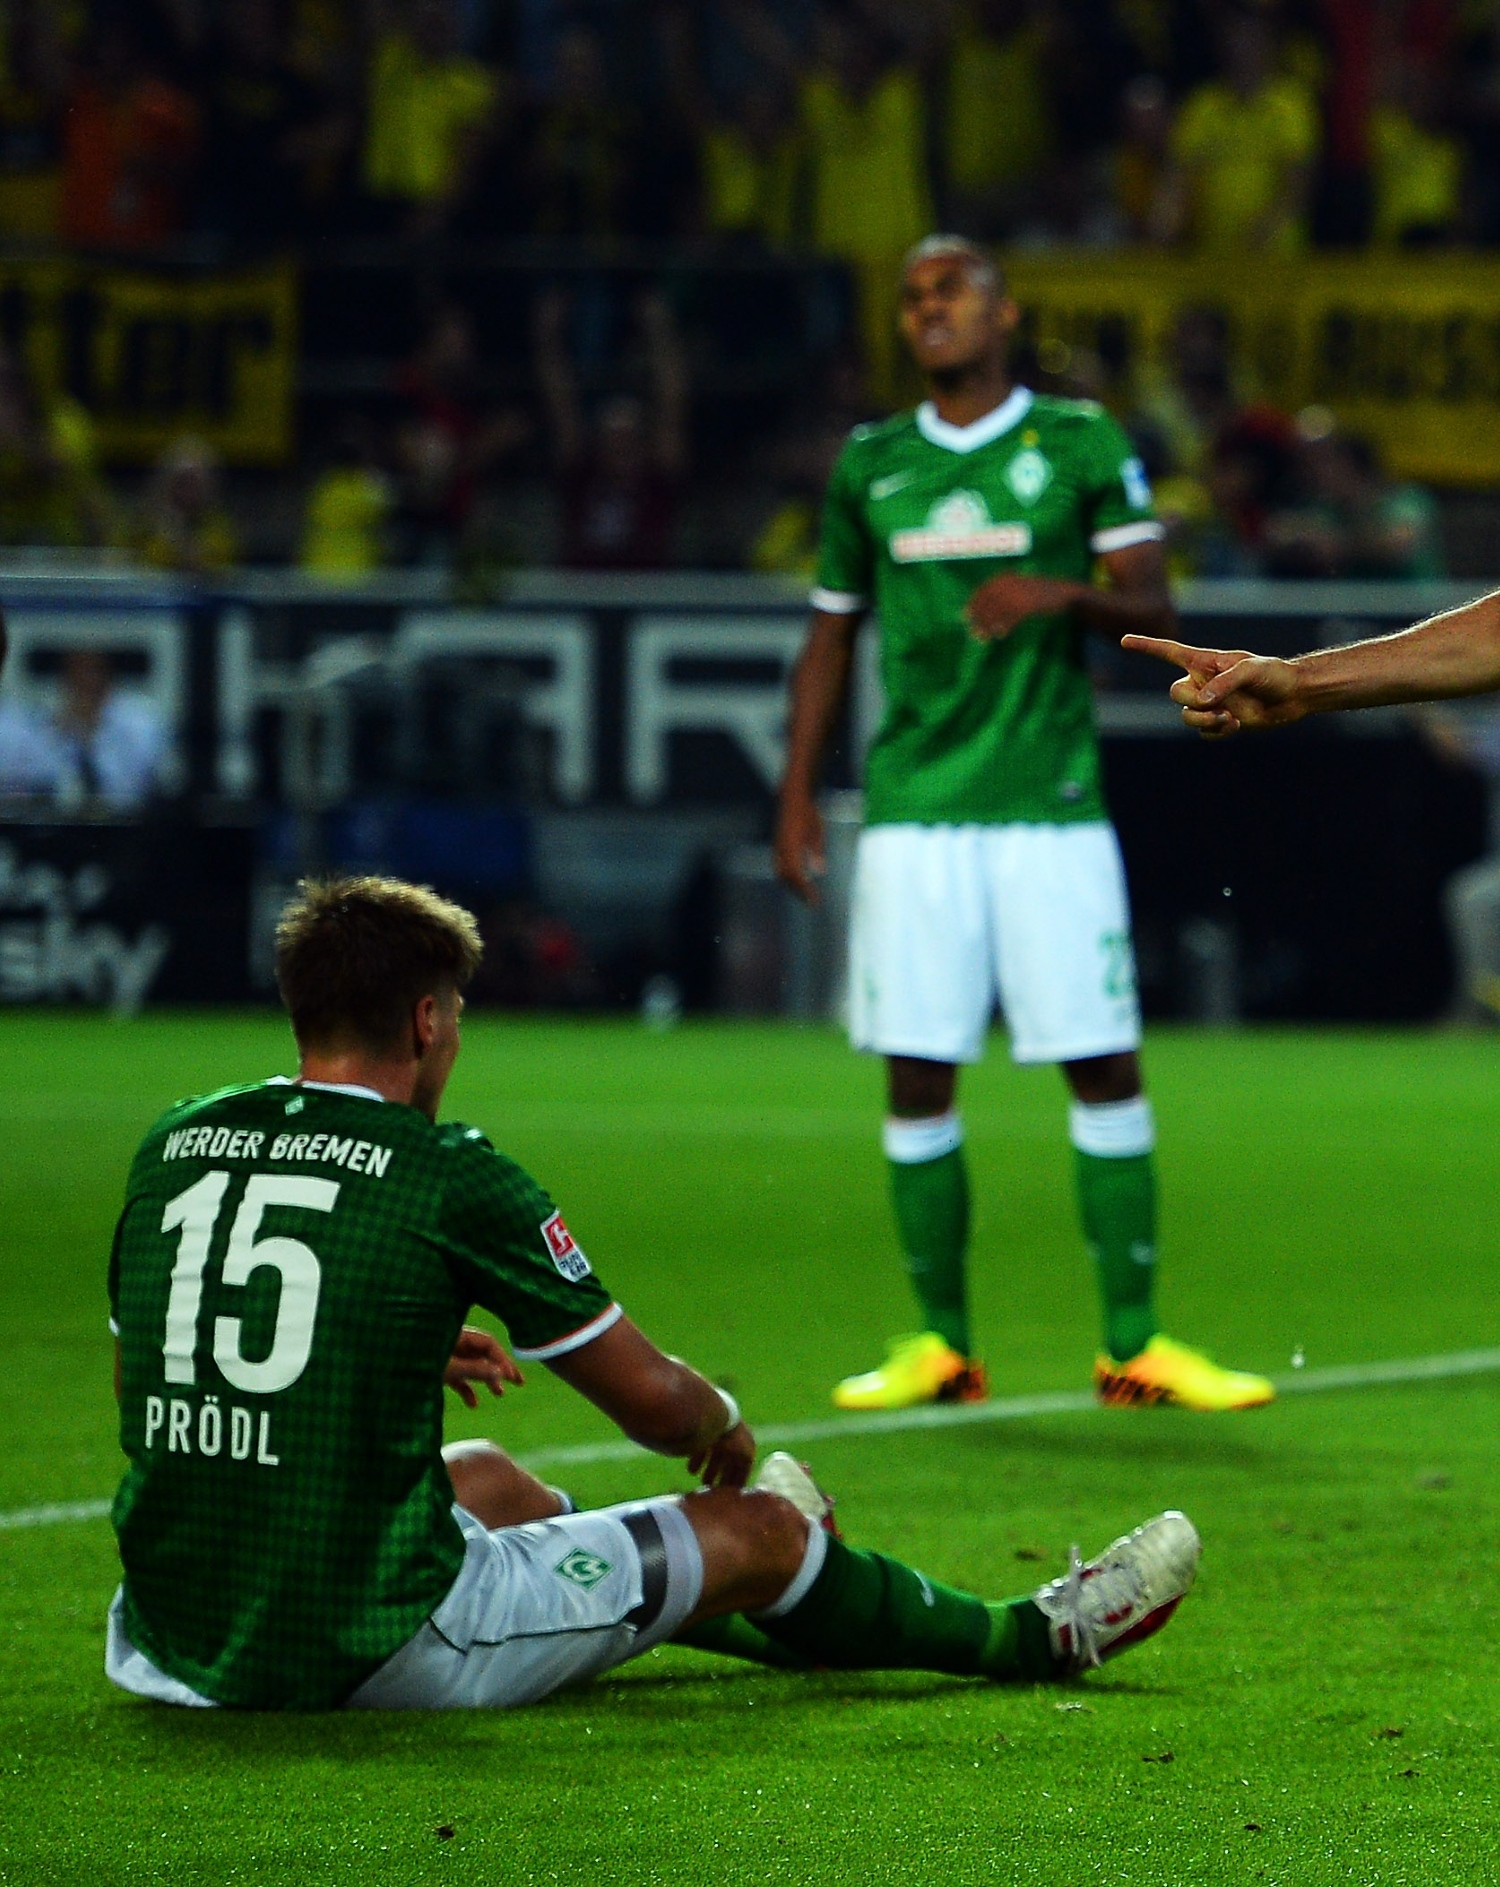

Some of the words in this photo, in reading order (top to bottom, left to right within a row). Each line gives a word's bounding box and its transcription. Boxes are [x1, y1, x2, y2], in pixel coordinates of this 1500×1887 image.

[162, 1126, 265, 1162] WERDER
[268, 1132, 394, 1178] BREMEN
[160, 1169, 342, 1394] 15
[144, 1394, 280, 1467] PRÖDL
